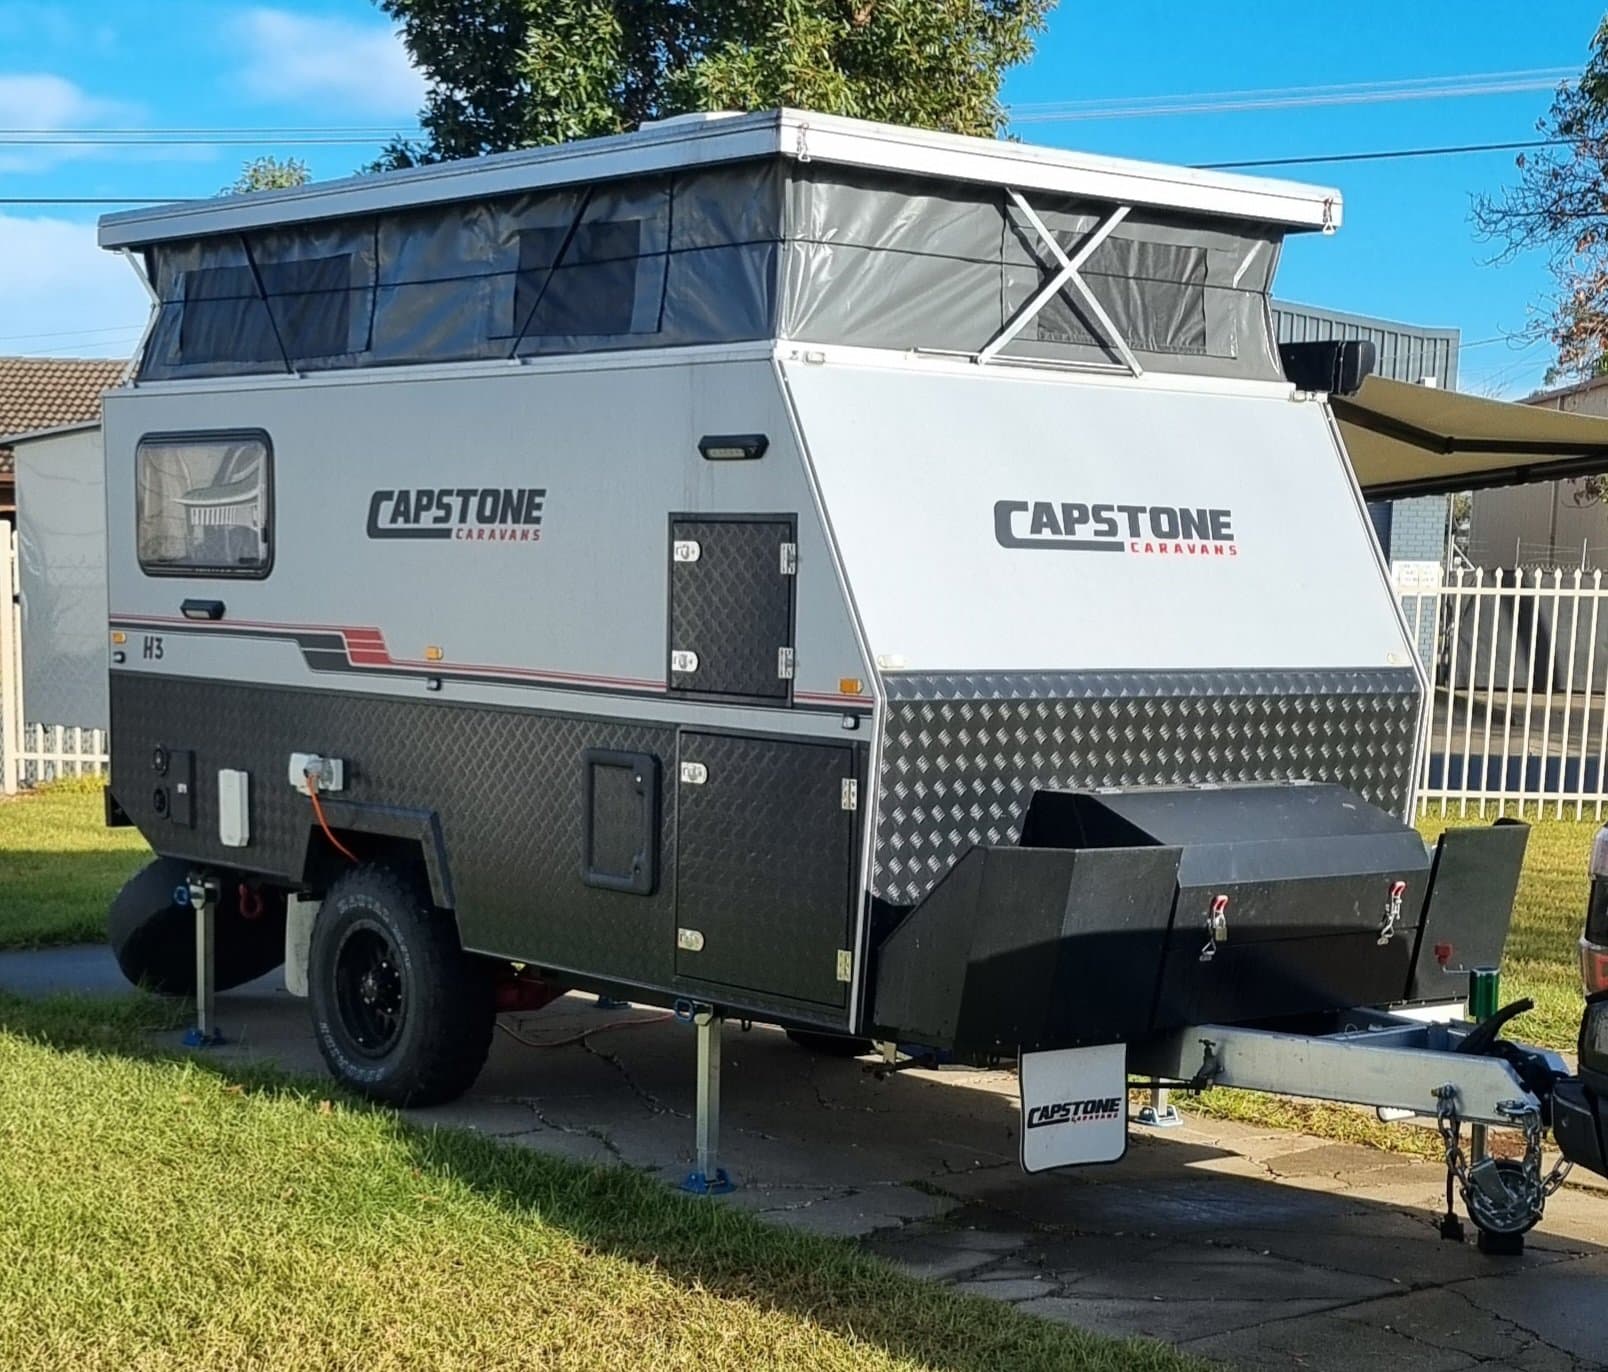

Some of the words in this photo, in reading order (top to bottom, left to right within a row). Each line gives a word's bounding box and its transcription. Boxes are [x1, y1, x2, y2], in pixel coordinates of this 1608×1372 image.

[366, 488, 547, 539] CAPSTONE
[994, 500, 1235, 552] CAPSTONE
[455, 528, 541, 541] CARAVANS
[1130, 542, 1238, 556] CARAVANS
[143, 635, 164, 660] H3
[1027, 1097, 1122, 1129] CAPSTONE
